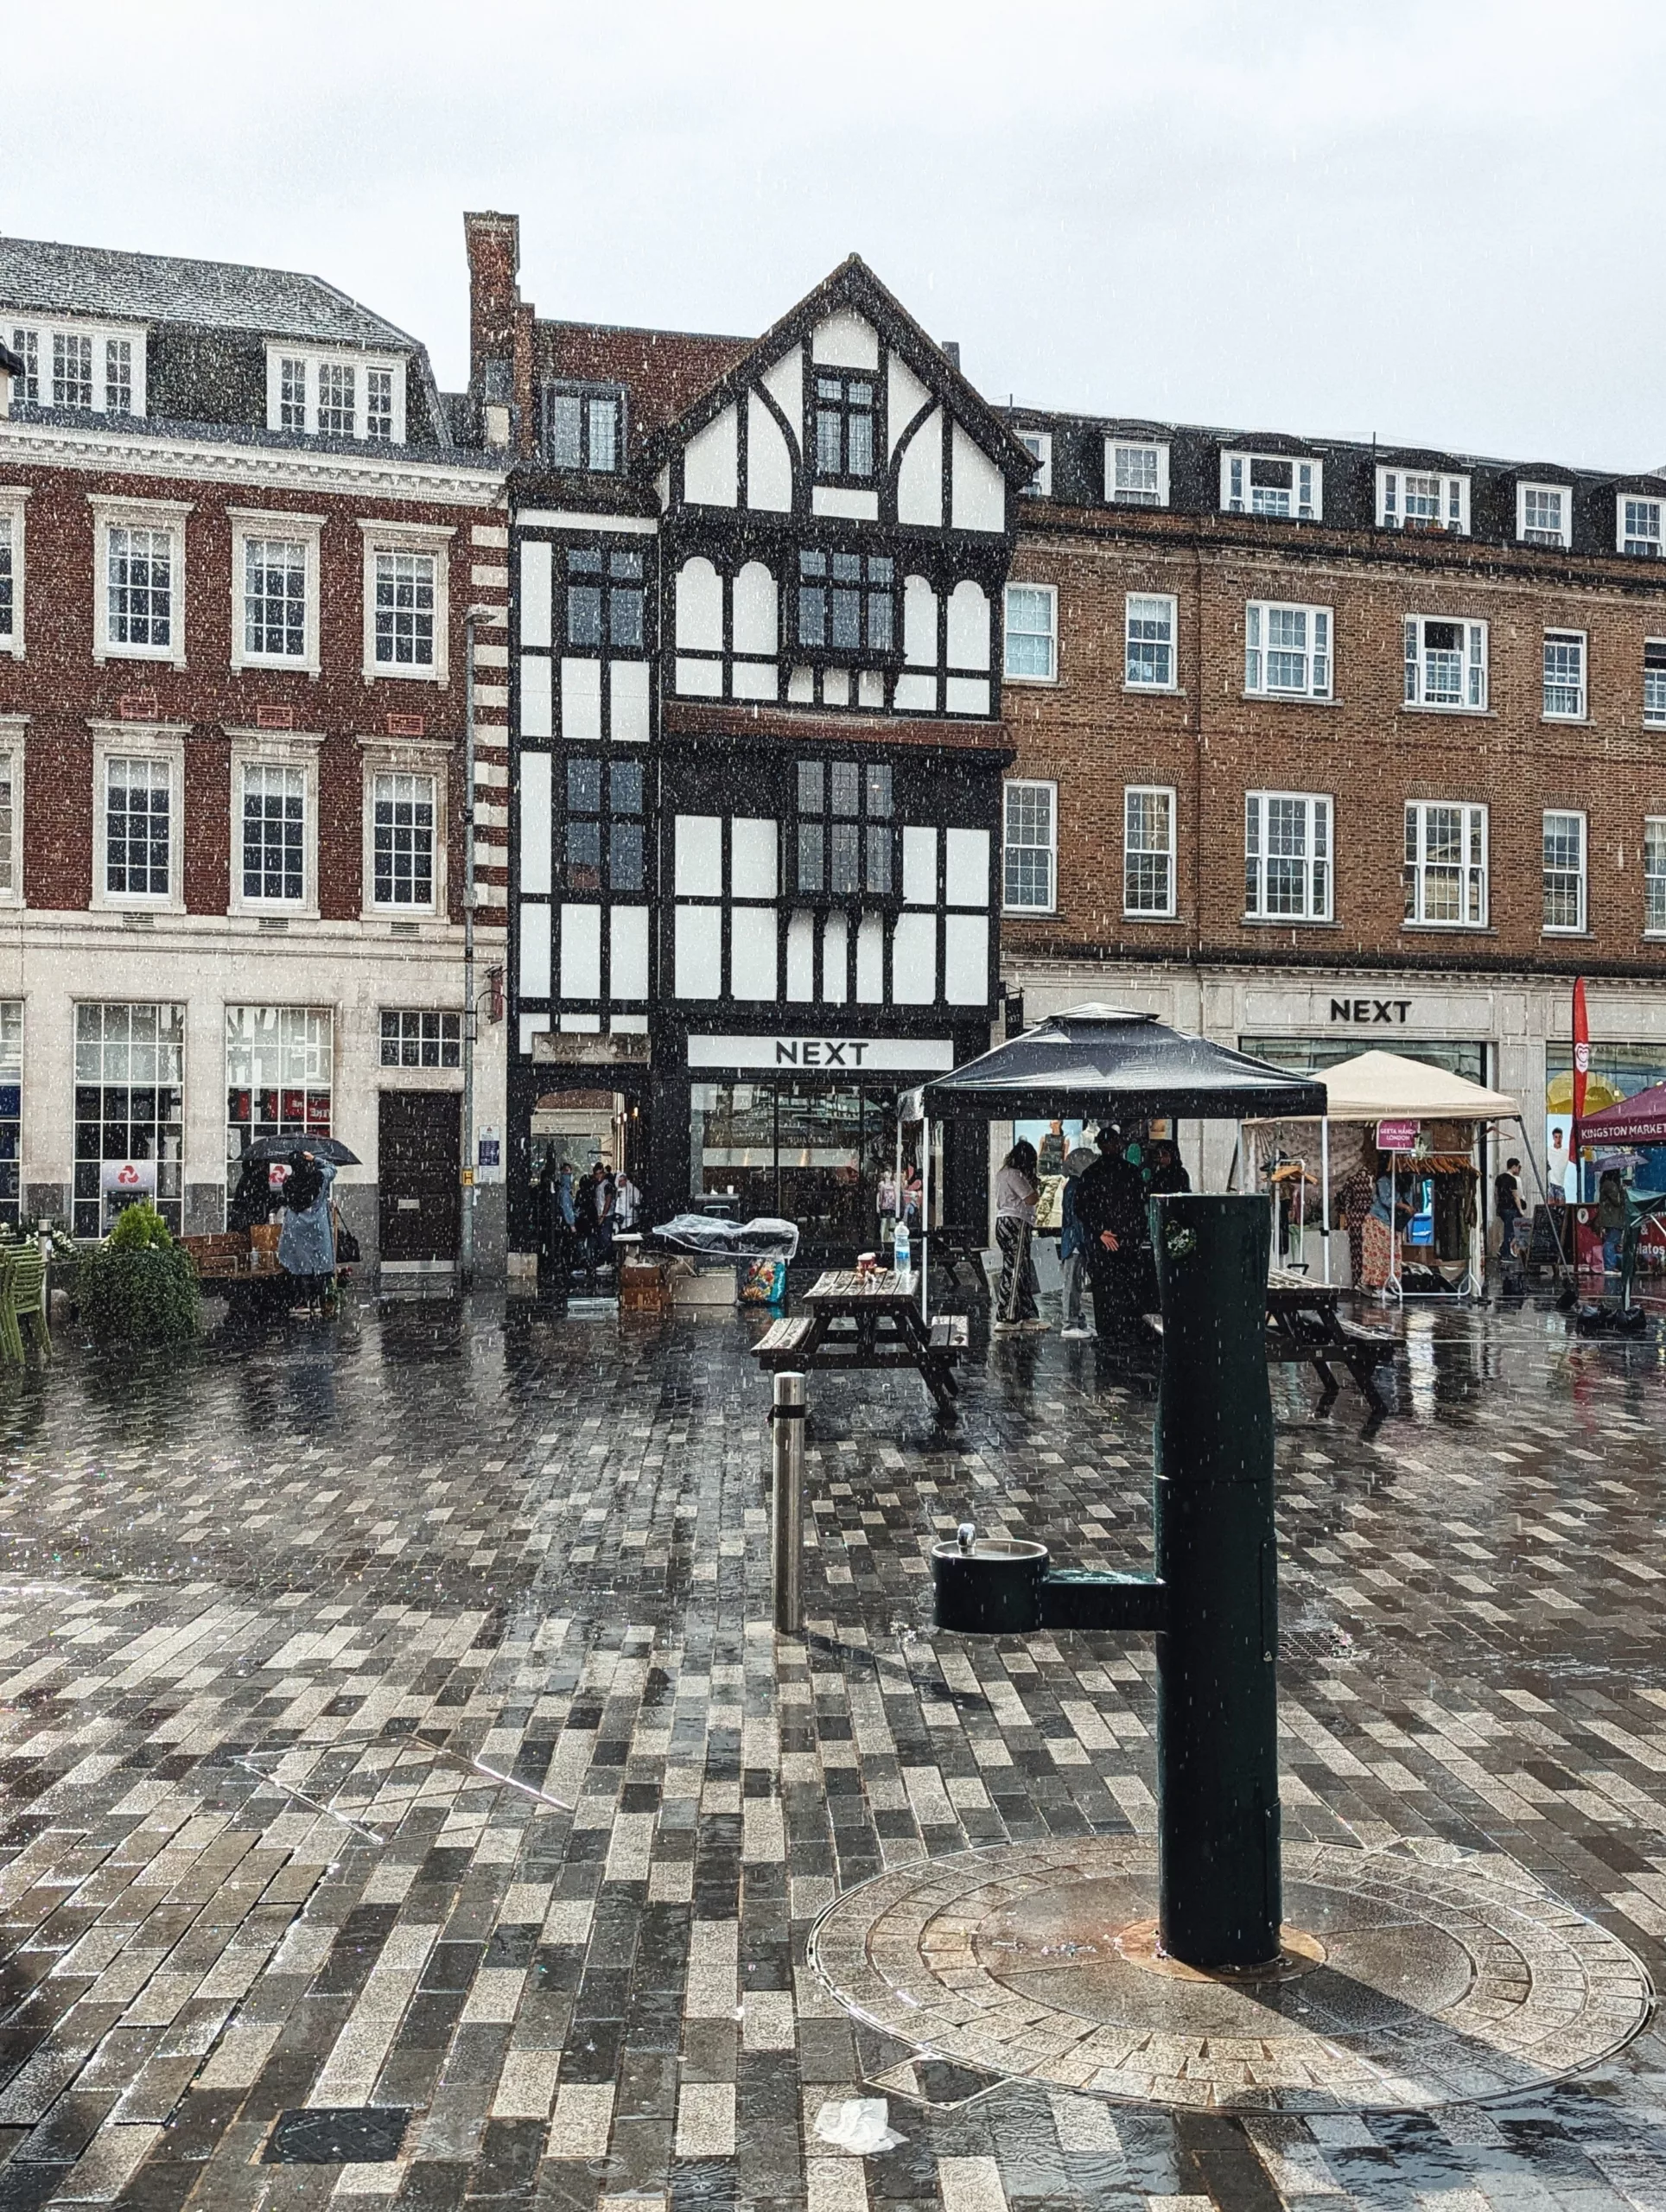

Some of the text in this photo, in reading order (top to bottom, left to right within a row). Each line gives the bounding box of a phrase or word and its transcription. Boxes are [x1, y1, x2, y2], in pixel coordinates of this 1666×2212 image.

[1331, 998, 1412, 1023] NEXT
[776, 1039, 869, 1065] NEXT
[1581, 1123, 1666, 1139] KINGSTON MARKET
